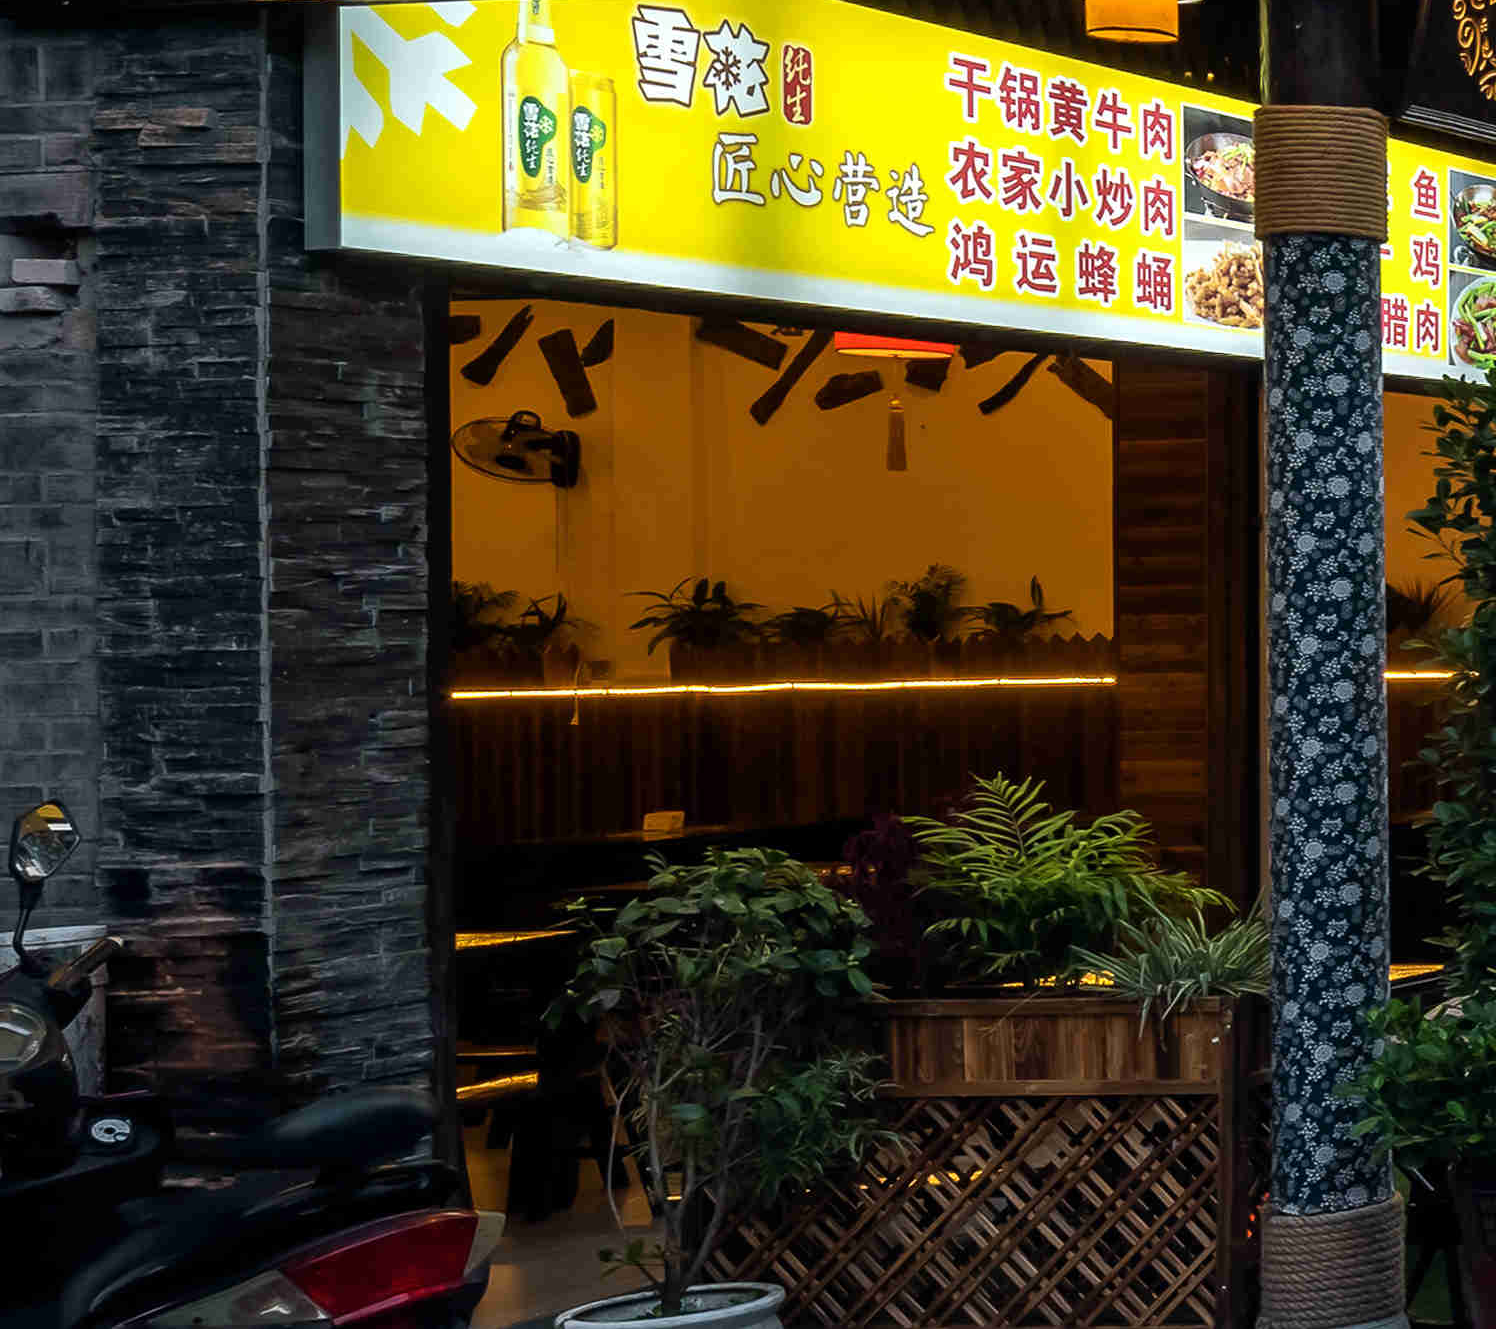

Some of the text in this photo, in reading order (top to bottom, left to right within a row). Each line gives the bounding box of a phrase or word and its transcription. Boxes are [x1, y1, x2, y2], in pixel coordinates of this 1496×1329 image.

[632, 4, 770, 118] 雪花
[783, 46, 812, 124] 纯生
[948, 56, 1174, 161] 干锅黄牛肉
[712, 131, 935, 239] 匠心营造
[948, 141, 1174, 236] 农家小炒肉
[948, 222, 1174, 313] 鸿运蜂蛹
